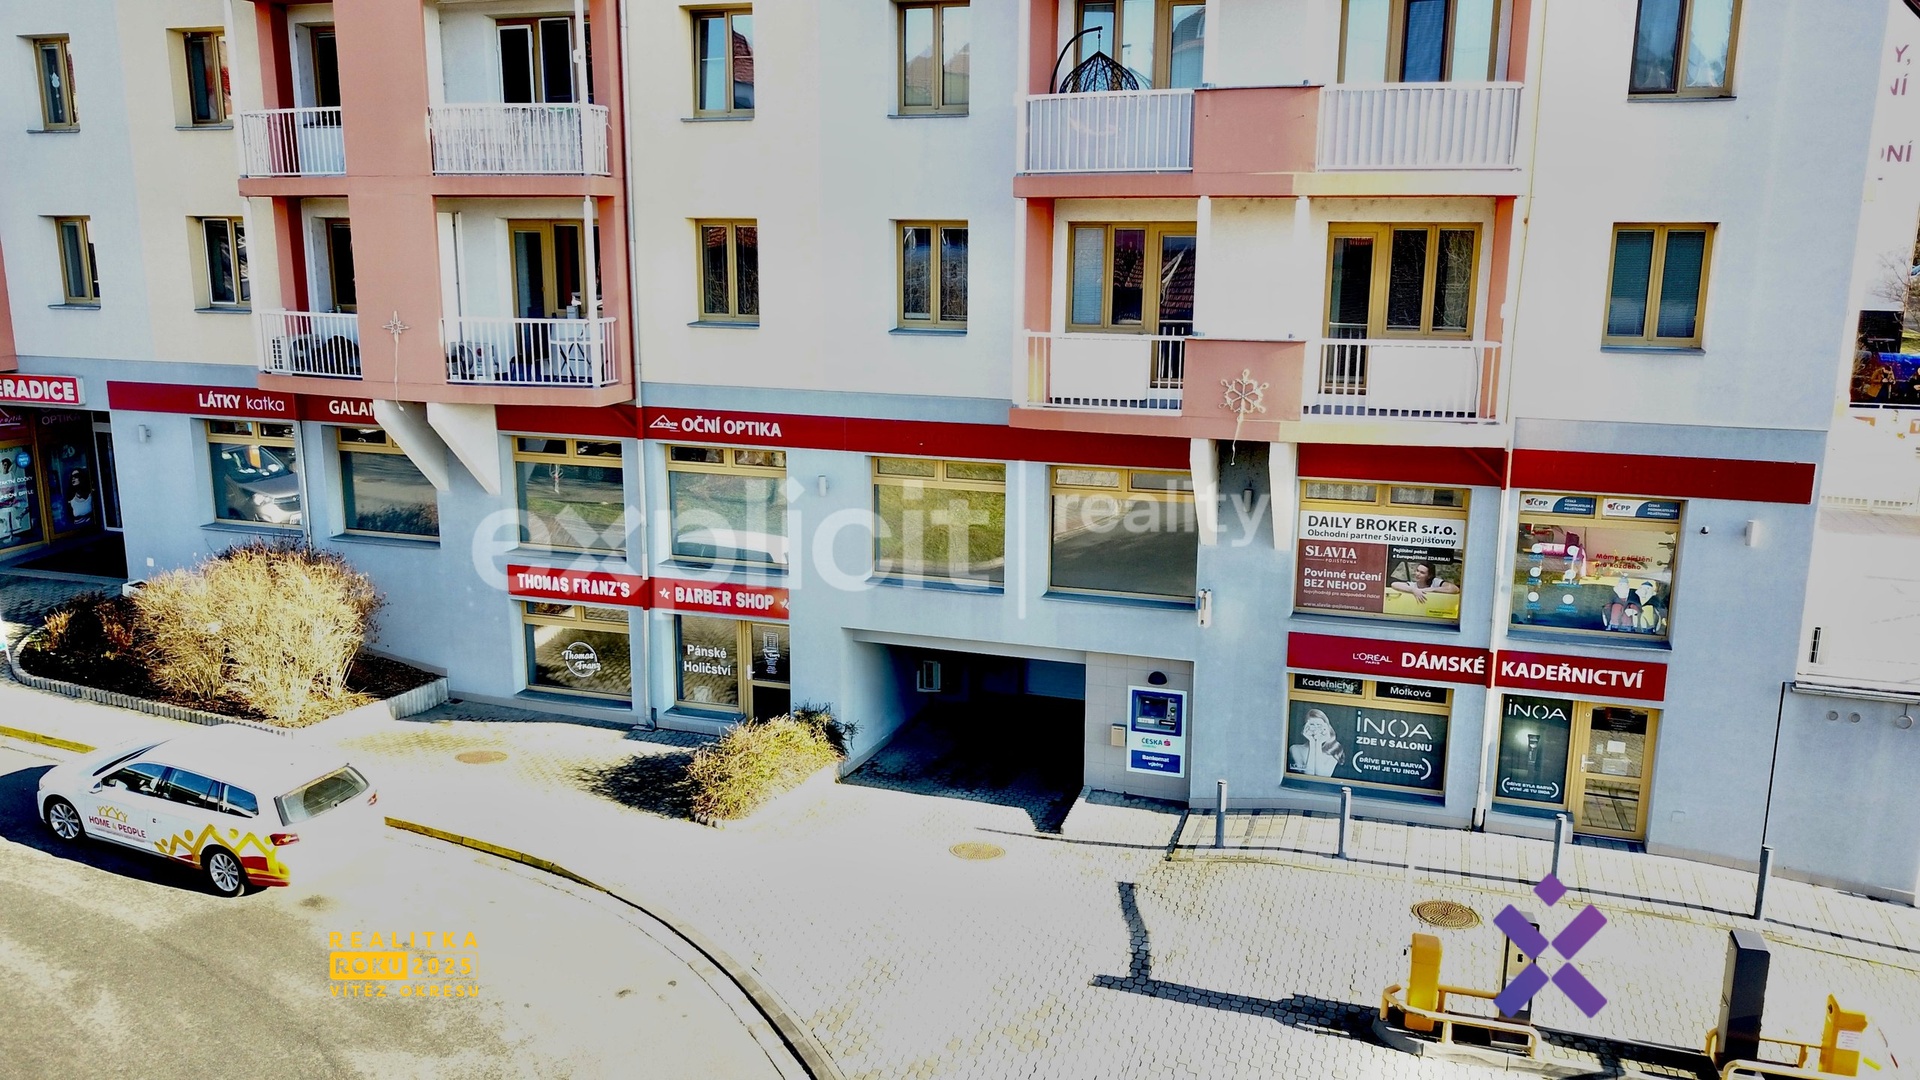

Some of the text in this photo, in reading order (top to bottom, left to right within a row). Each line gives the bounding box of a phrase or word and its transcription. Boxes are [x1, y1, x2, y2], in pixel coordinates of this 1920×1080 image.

[199, 390, 285, 412] LÁTKY katka
[681, 415, 782, 437] OČNÍ OPTIKA
[1308, 515, 1457, 536] DAILY BROKER s.r.o.
[1307, 529, 1456, 547] Obchodní partner Slavia pojišťovny
[1305, 545, 1357, 559] SLAVIA
[1304, 568, 1382, 582] Povinné ručení
[517, 573, 630, 597] THOMAS FRANZ'S
[1303, 578, 1367, 591] BEZ NEHOD
[675, 586, 774, 610] BARBER SHOP
[561, 650, 595, 660] Thomas
[687, 644, 727, 659] Pánské
[575, 660, 601, 671] Franz
[683, 660, 732, 676] Holičství
[1401, 651, 1645, 688] DÁMSKÉ KADEŘNICTVÍ
[1356, 736, 1433, 752] ZDE V SALONU
[1359, 756, 1425, 770] DŘÍVE BYLA BARVA,
[1363, 763, 1380, 771] NYNÍ
[1403, 767, 1420, 775] INOA
[88, 815, 111, 828] HOME
[117, 823, 147, 839] PEOPLE
